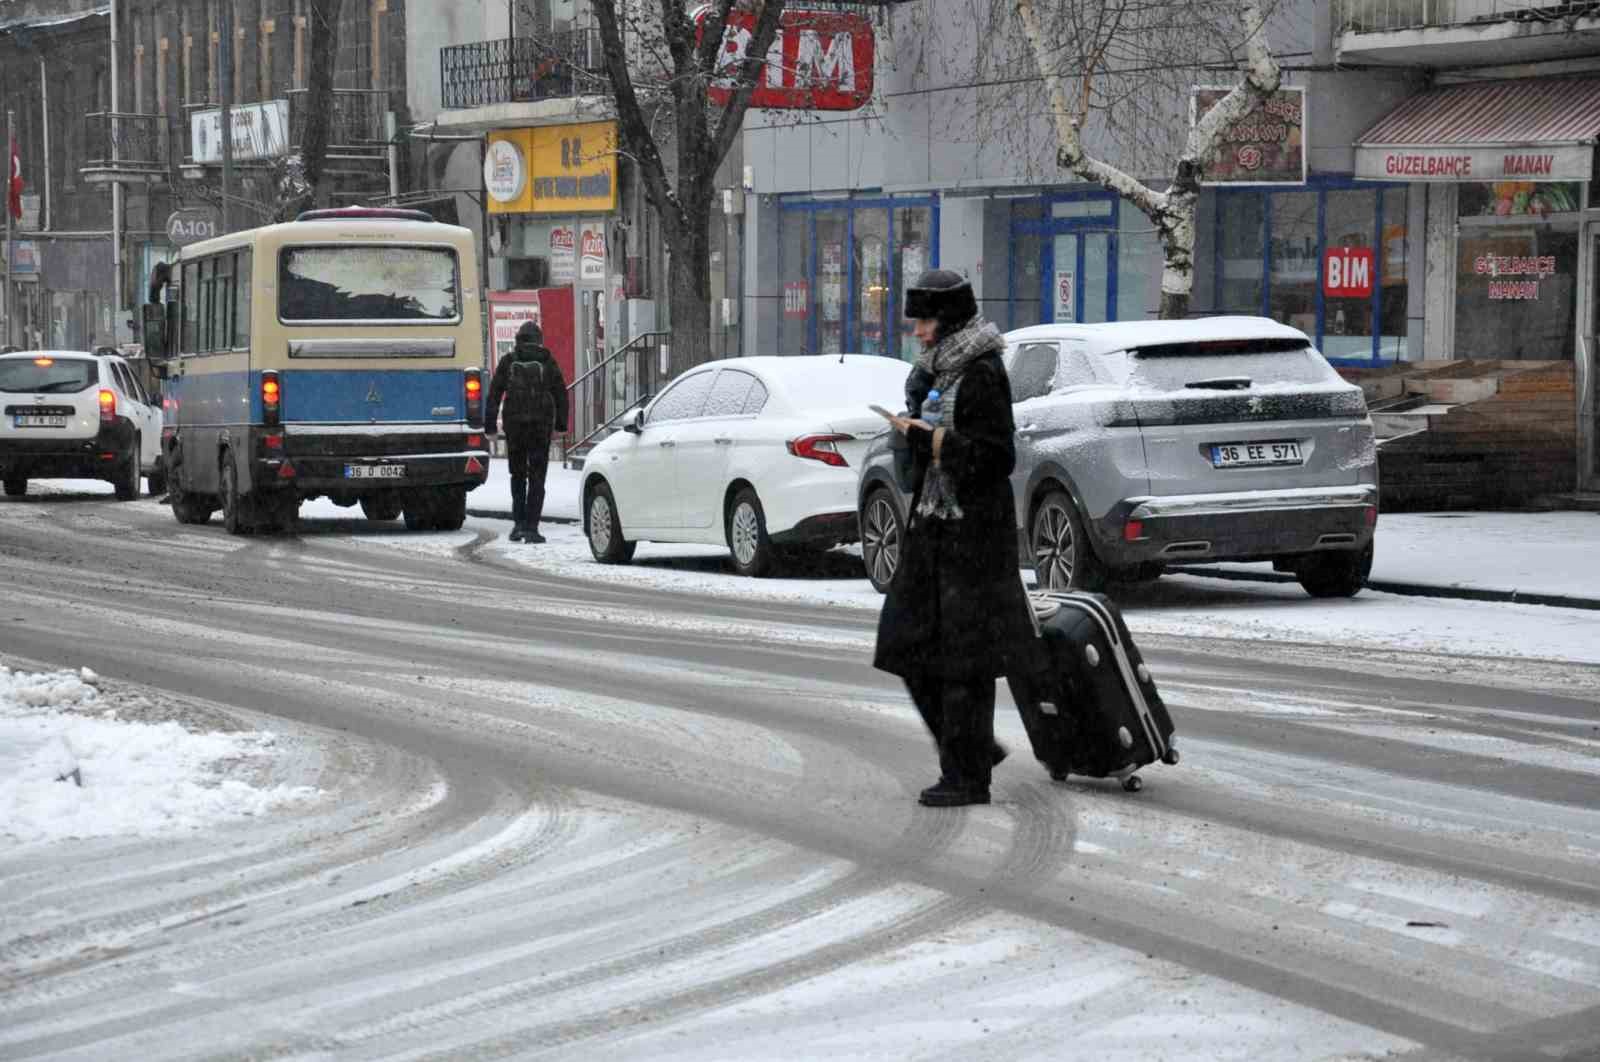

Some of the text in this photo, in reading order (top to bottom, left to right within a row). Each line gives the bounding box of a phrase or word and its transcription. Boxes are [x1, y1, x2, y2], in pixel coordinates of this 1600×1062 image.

[1386, 154, 1554, 177] GÜZELBAHÇE MANAV
[1327, 247, 1369, 288] BİM
[1221, 444, 1297, 460] 36 EE 571
